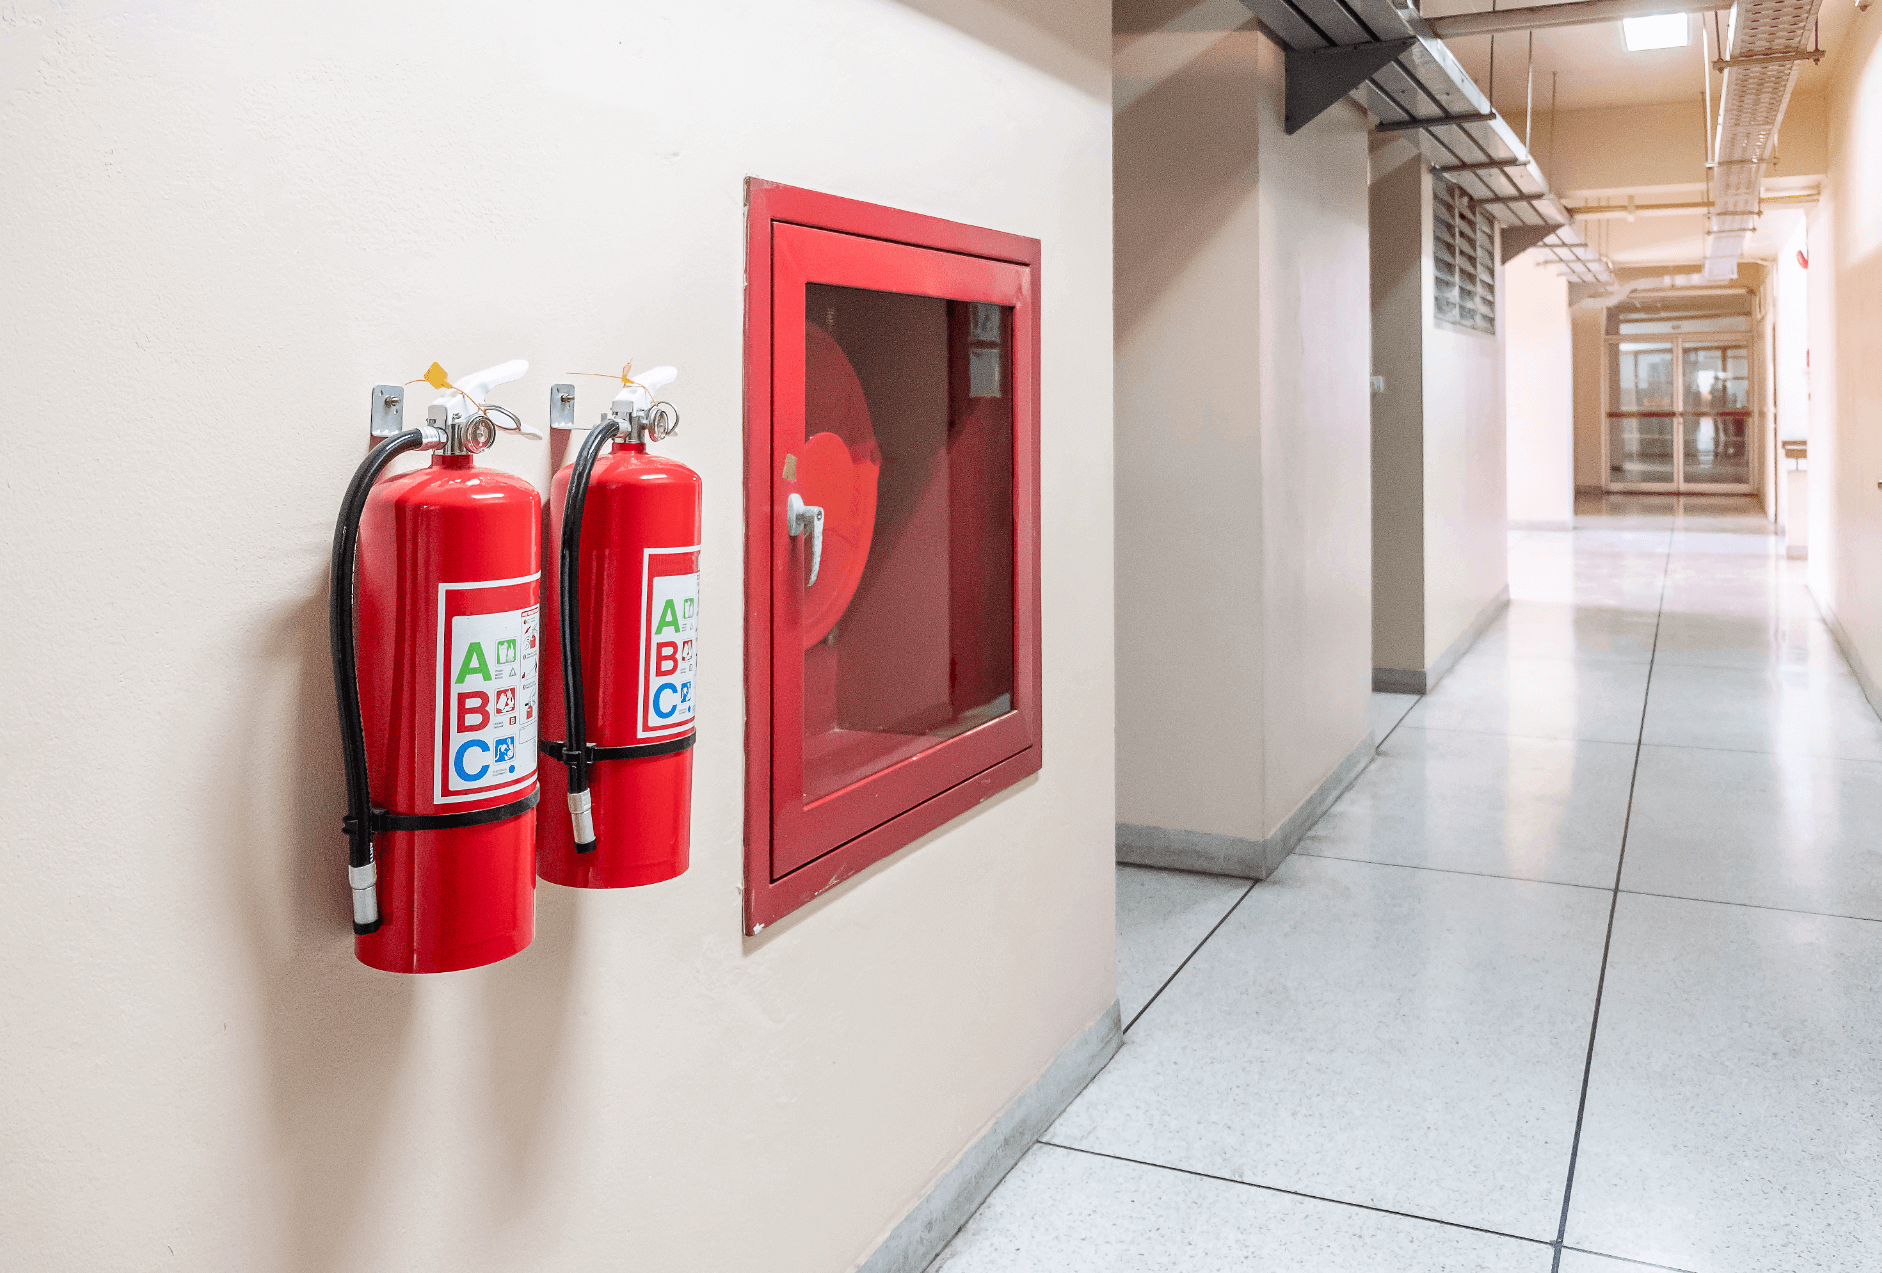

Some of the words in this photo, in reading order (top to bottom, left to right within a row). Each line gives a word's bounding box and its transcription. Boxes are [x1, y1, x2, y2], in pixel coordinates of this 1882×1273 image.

[654, 599, 681, 635] A
[455, 642, 492, 685] A
[655, 641, 679, 678] B
[457, 691, 491, 734] B
[652, 682, 679, 719] C
[453, 739, 491, 782] C
